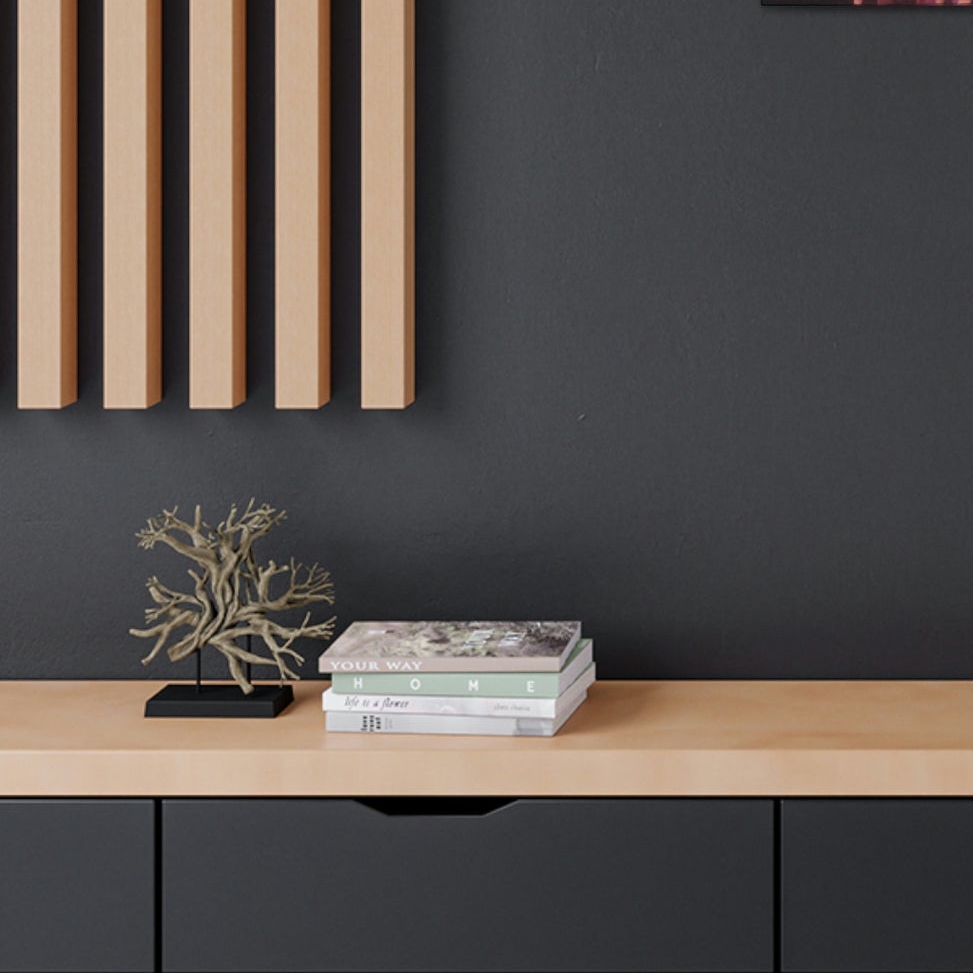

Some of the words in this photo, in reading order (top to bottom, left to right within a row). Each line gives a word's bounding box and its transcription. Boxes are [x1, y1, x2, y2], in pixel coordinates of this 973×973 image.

[330, 661, 379, 671] YOUR
[386, 661, 422, 671] WAY
[353, 677, 535, 693] HOME
[344, 696, 359, 710] life
[380, 697, 410, 711] flower
